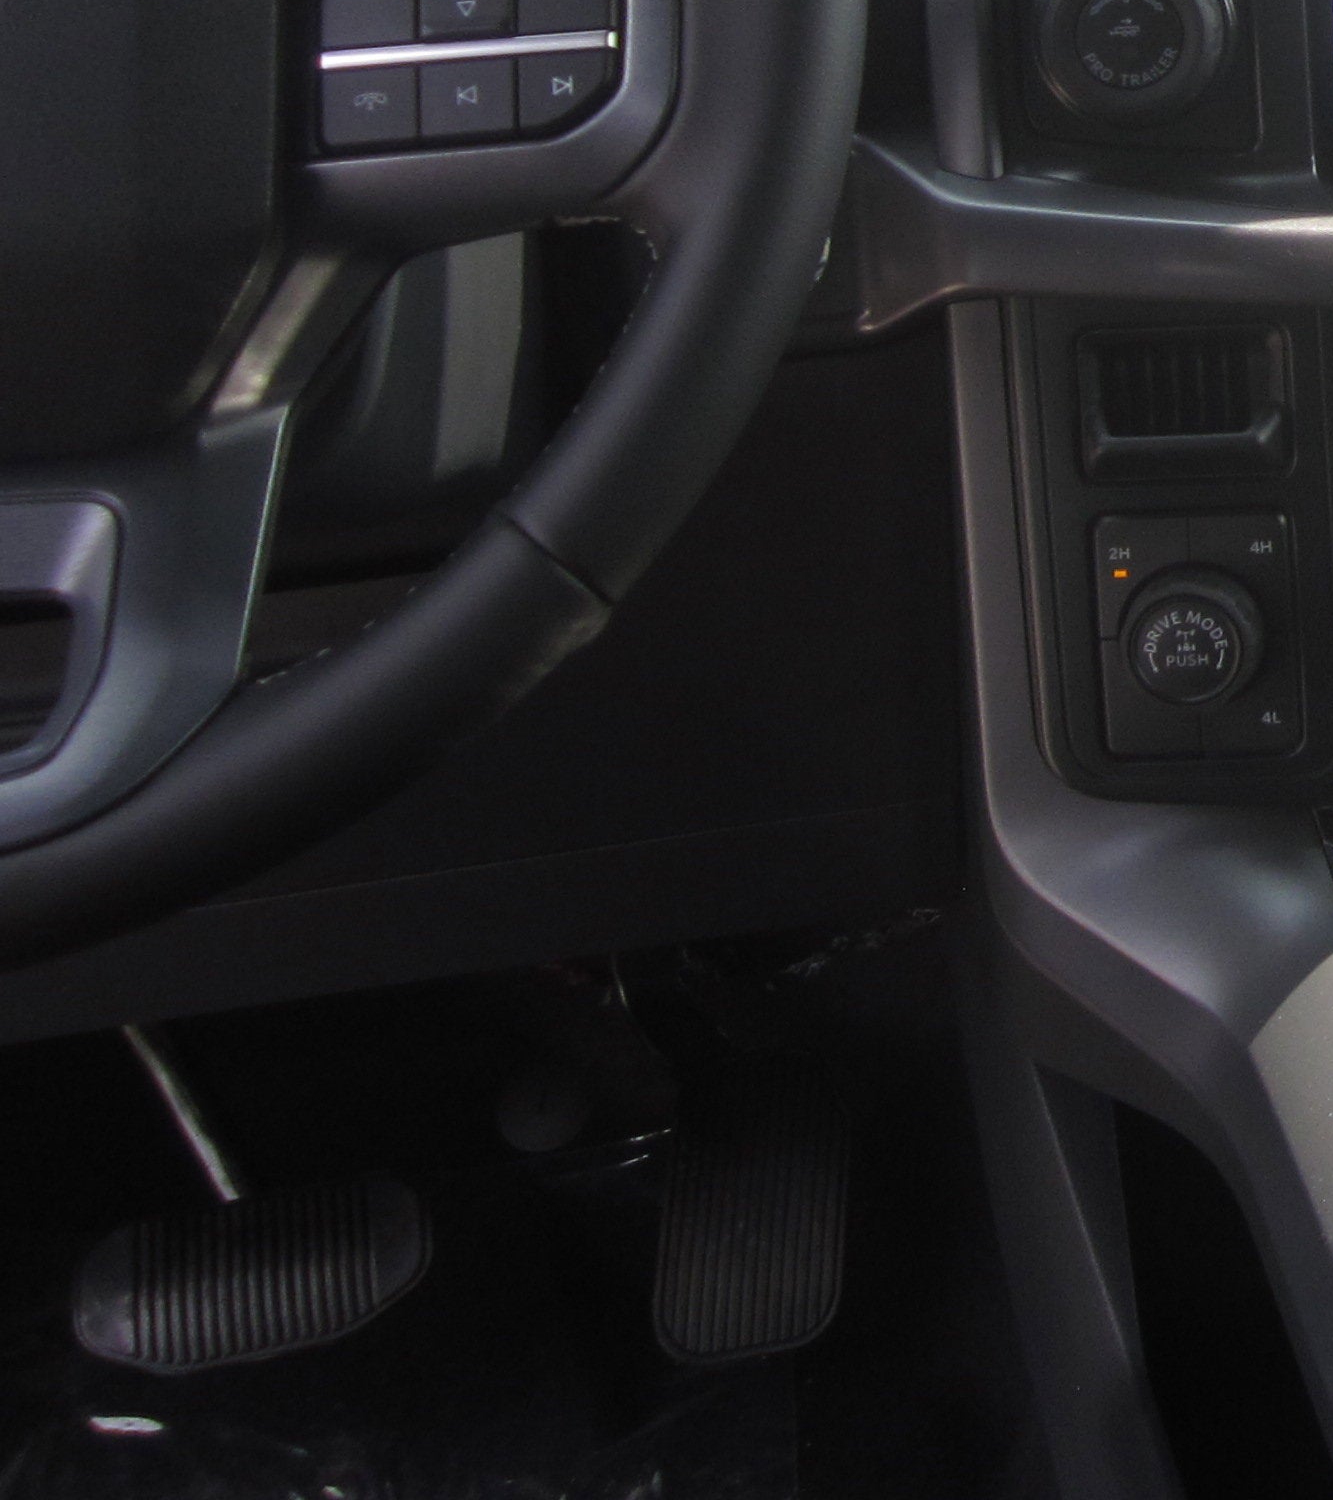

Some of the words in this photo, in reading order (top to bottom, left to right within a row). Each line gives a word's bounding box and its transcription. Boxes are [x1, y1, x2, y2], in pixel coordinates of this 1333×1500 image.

[1083, 52, 1113, 83] PRO
[1121, 47, 1178, 86] TRAILER
[1250, 540, 1272, 553] 4H
[1108, 548, 1130, 560] 2H
[1144, 611, 1182, 653] DRIVE
[1185, 610, 1228, 650] MODE
[1166, 655, 1209, 667] PUSH
[1261, 712, 1281, 724] 4L
